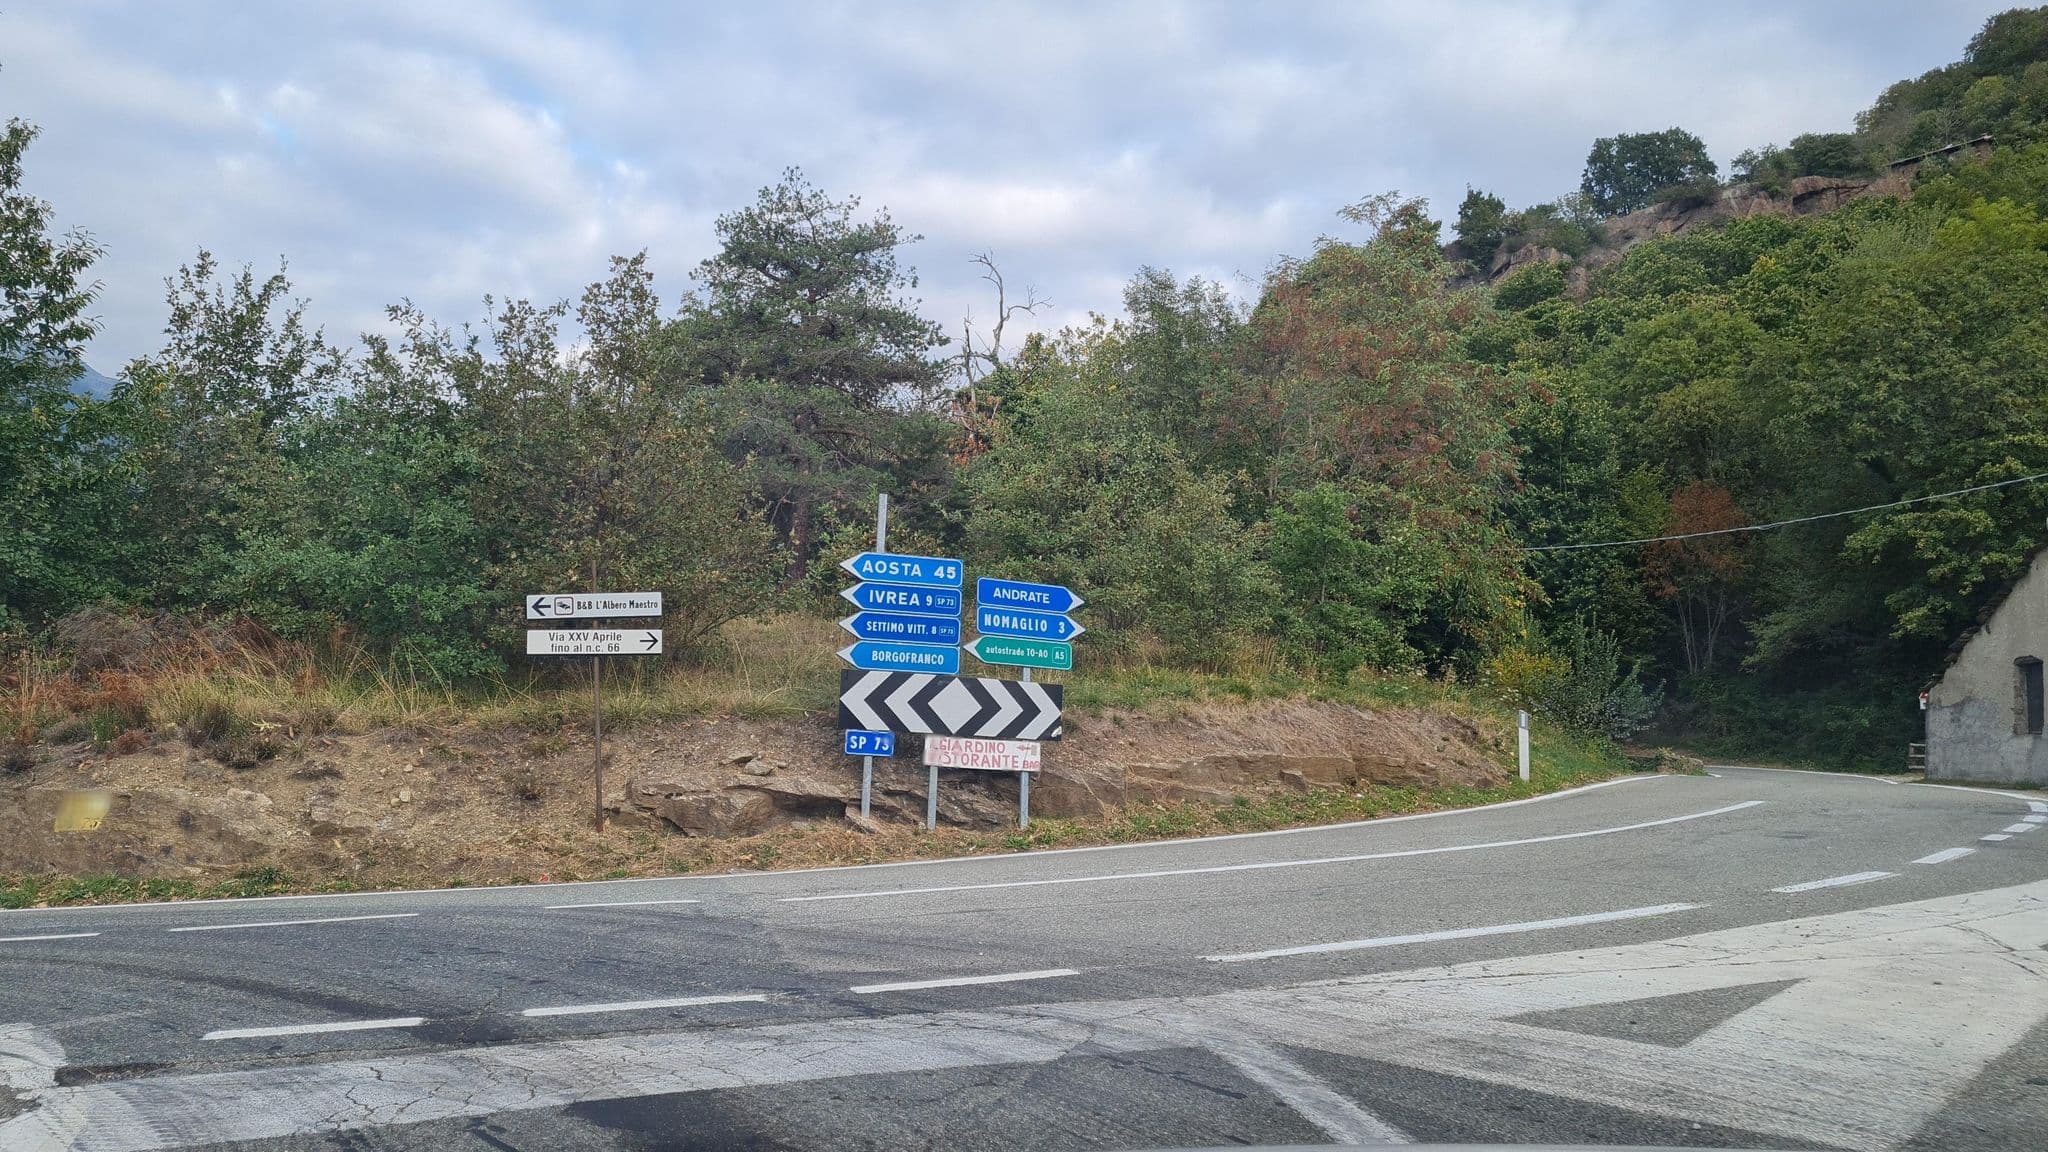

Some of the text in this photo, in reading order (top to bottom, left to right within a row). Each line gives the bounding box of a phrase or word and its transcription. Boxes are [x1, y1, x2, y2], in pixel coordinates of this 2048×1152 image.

[862, 560, 956, 579] AOSTA 45
[869, 590, 954, 606] IVREA 9 SP 73
[993, 587, 1050, 604] ANDRATE
[577, 600, 658, 610] B&B L'Albero Maestro
[866, 621, 904, 633] SETTIMO
[907, 623, 929, 635] VITT.
[931, 625, 937, 635] 8
[984, 613, 1065, 634] NOMAGLIO 3
[549, 632, 622, 643] Via XXV Aprile
[551, 643, 620, 652] fino al n.c. 66
[1026, 648, 1049, 658] TO-AO
[1054, 651, 1065, 660] A5
[872, 650, 945, 666] BORGOFRANCO
[850, 735, 867, 749] SP
[940, 738, 1006, 754] GIARDINO
